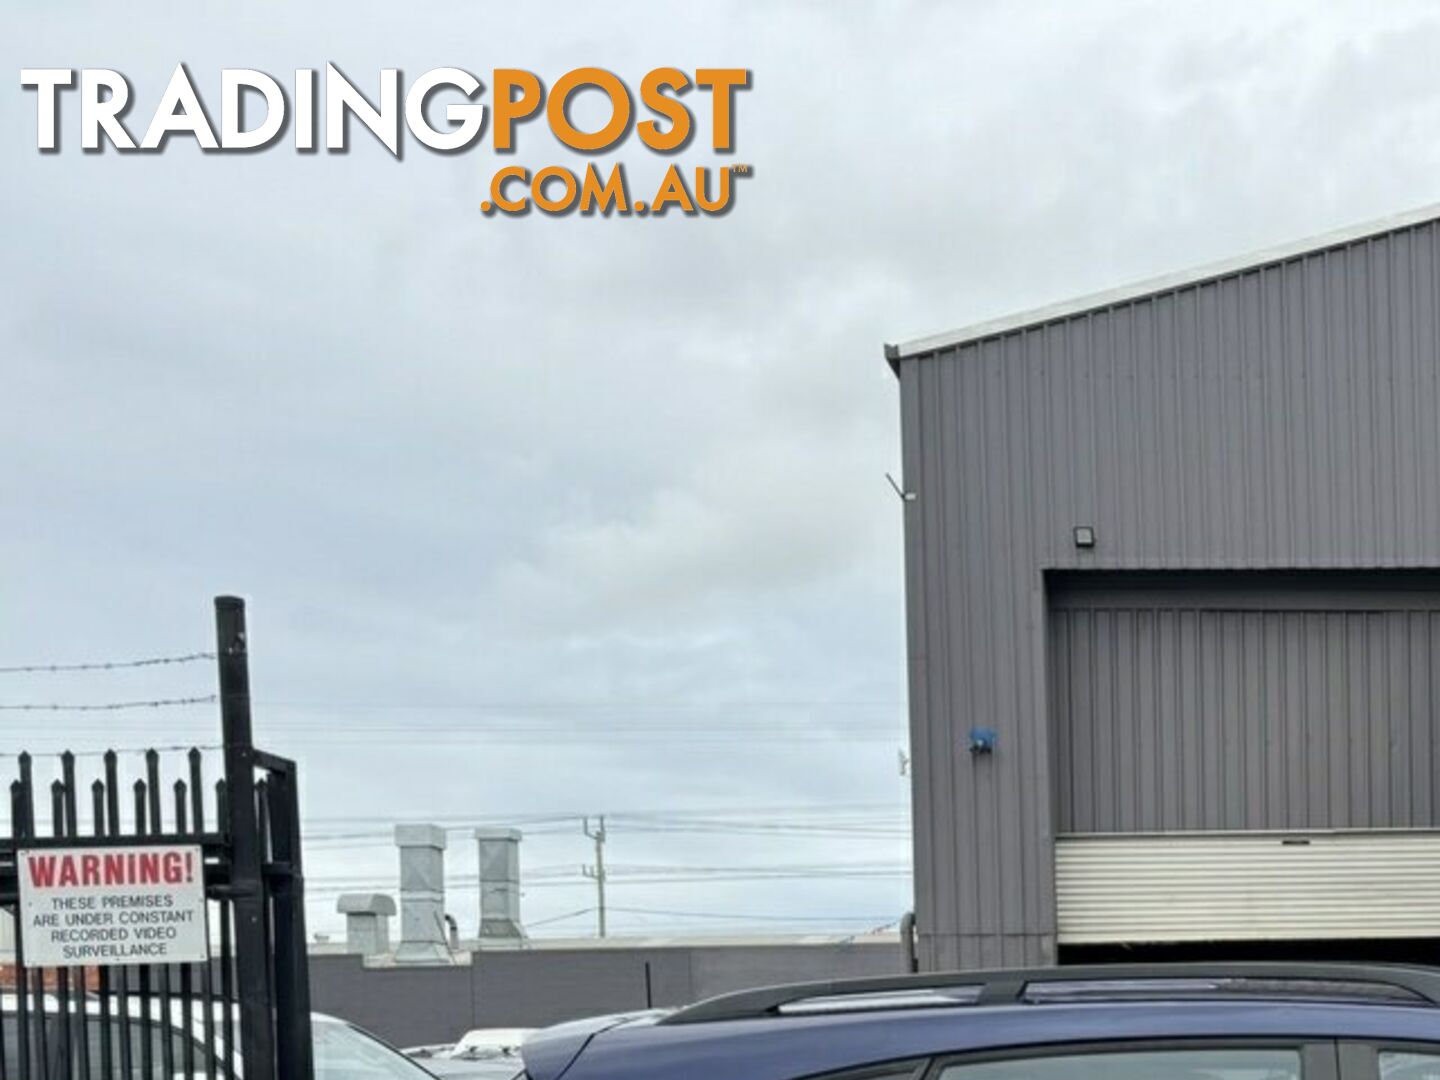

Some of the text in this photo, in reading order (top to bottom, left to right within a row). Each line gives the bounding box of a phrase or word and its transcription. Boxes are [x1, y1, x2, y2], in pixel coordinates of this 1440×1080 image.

[27, 852, 194, 888] WARNING!
[52, 894, 174, 910] THESE PREMISES
[33, 910, 194, 928] ARE UNDER CONSTANT
[51, 926, 177, 943] RECORDED VIDEO
[62, 942, 168, 960] SURVEILLANCE
